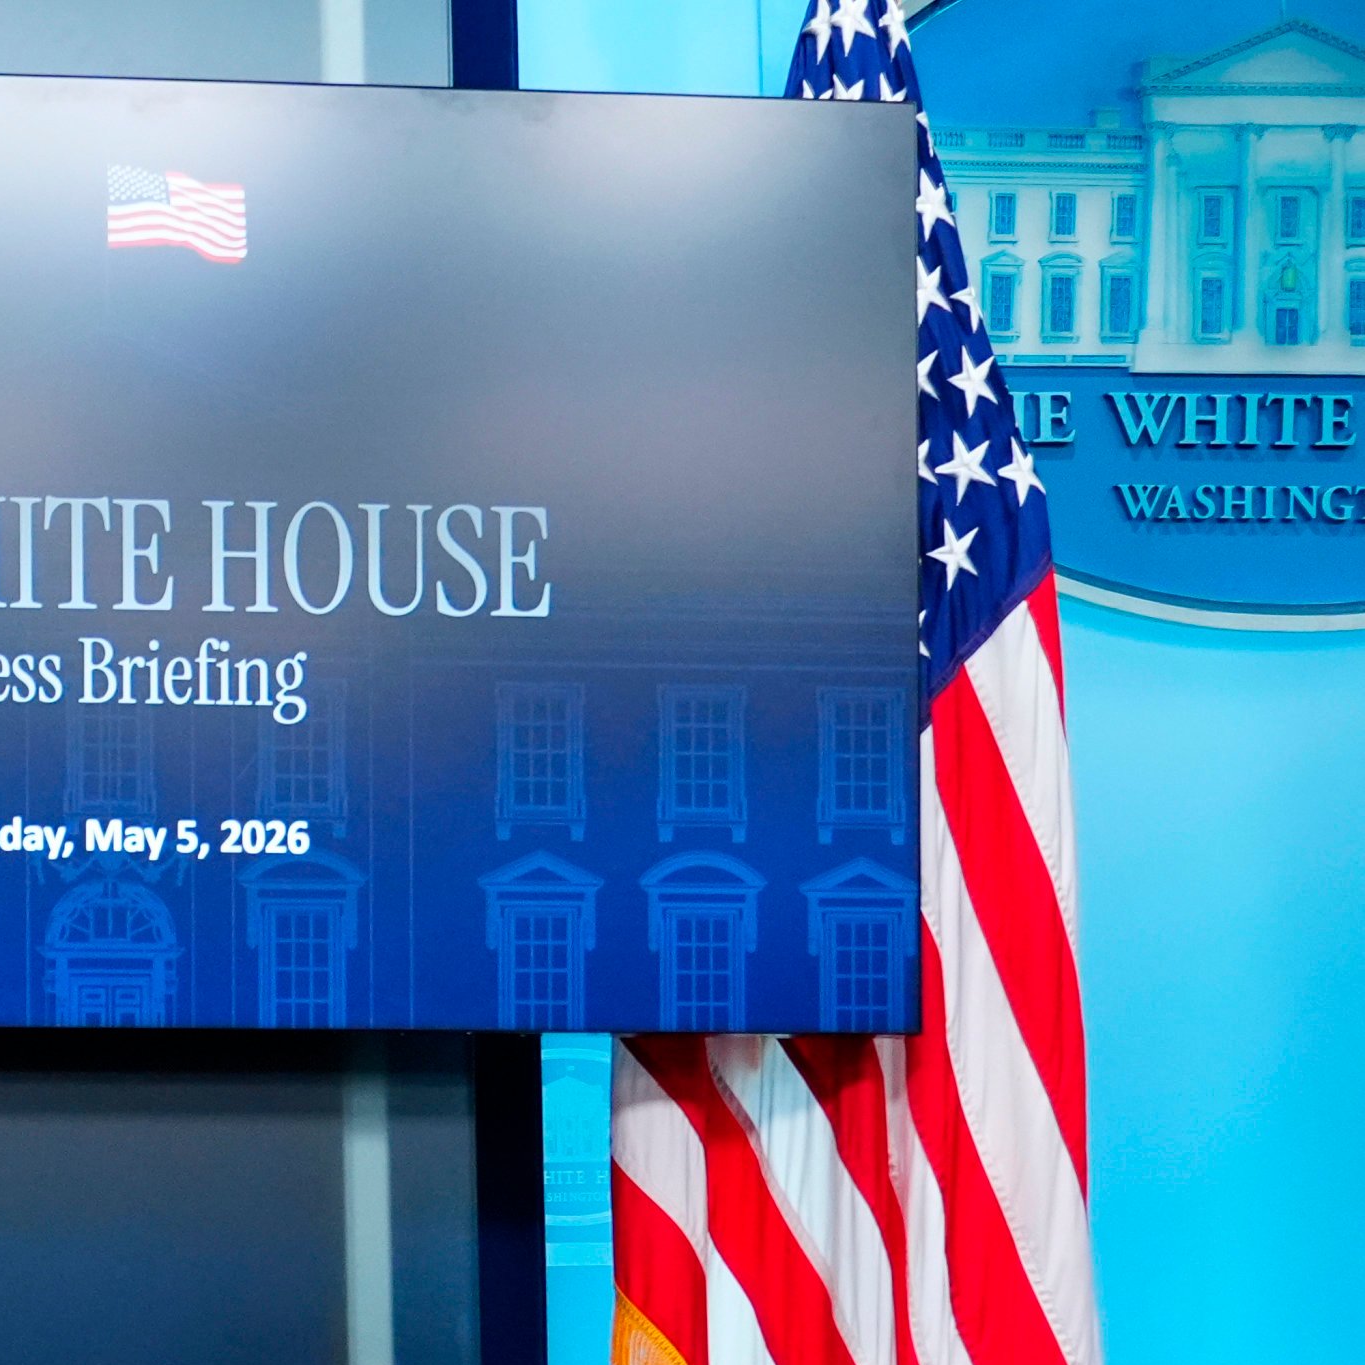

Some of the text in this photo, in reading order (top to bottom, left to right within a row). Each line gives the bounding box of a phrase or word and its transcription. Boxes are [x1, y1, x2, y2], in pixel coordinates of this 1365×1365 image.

[1106, 391, 1357, 445] WHITE
[202, 500, 552, 618] HOUSE
[77, 636, 308, 725] Briefing
[85, 818, 166, 861] May
[176, 819, 210, 859] 5,
[220, 819, 311, 855] 2026
[544, 1170, 587, 1185] HITE
